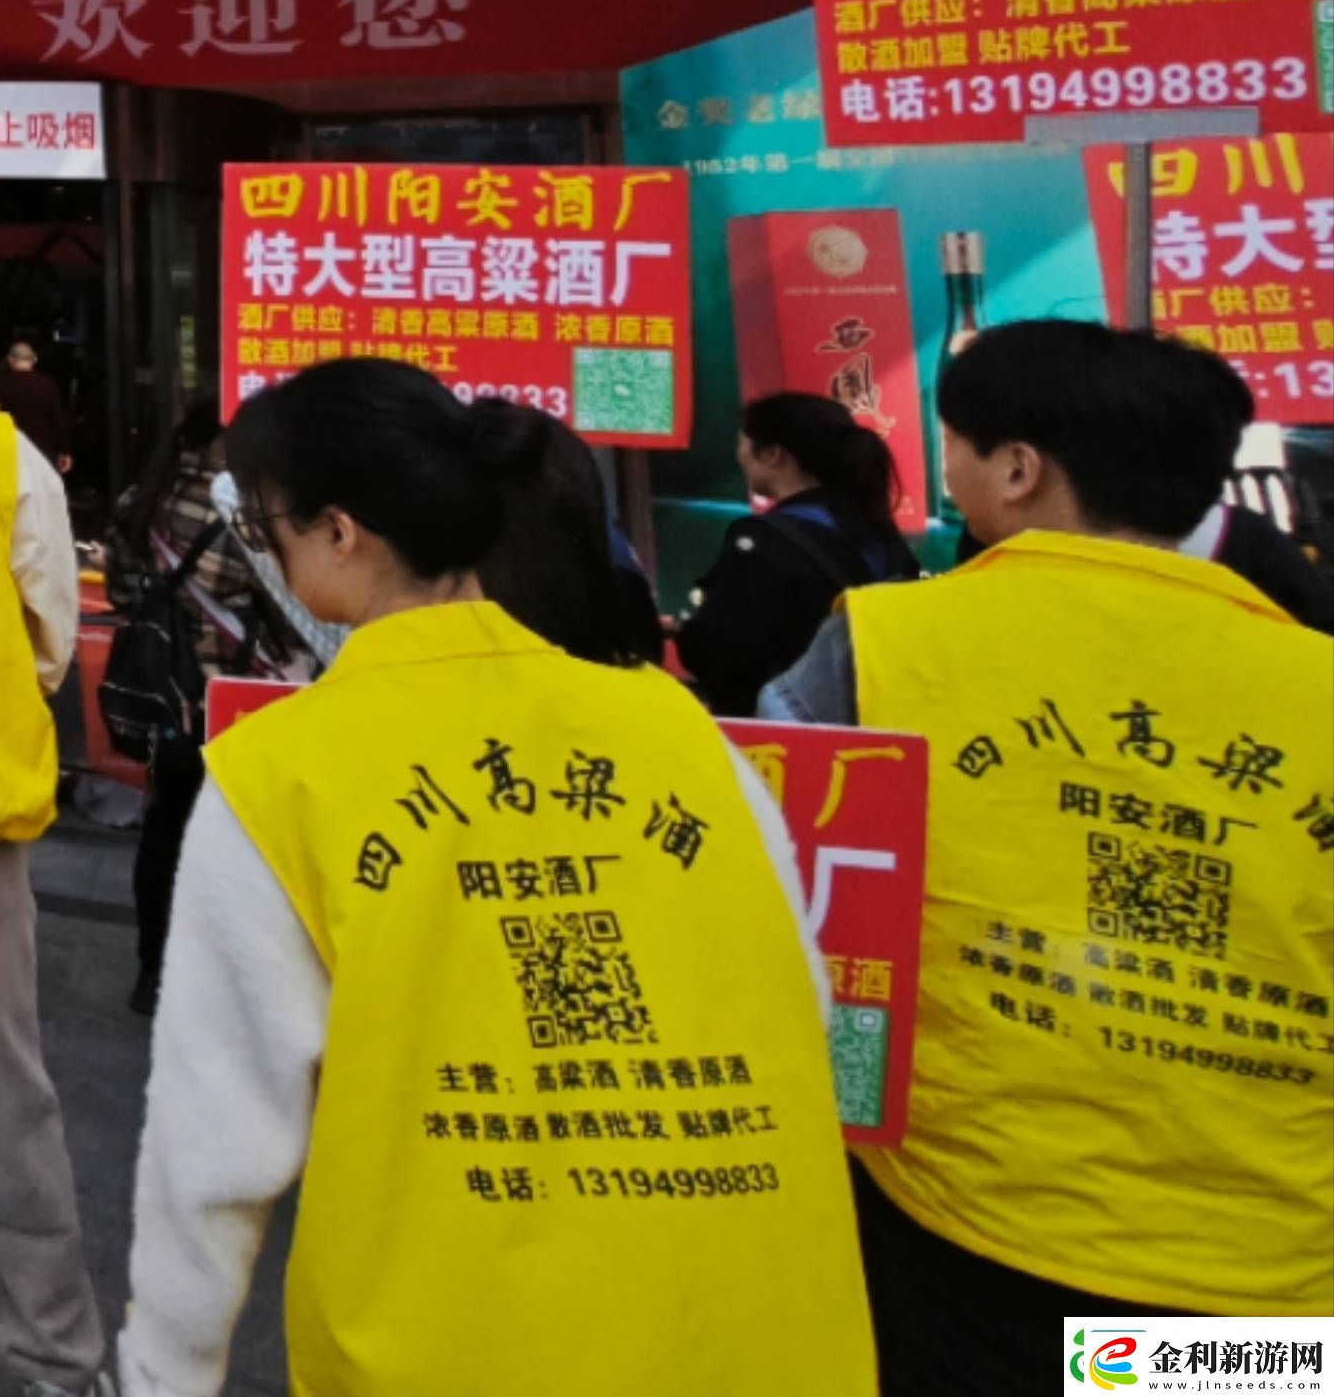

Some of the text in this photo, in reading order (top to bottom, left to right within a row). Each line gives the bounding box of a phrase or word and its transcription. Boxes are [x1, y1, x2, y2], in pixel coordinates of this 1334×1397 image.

[238, 165, 673, 231] 四川阳安酒厂
[243, 230, 672, 307] 特大型高粱酒厂
[1059, 781, 1259, 847] 阳安酒厂
[457, 853, 623, 901] 阳安酒厂
[628, 1054, 752, 1090] 清香原酒
